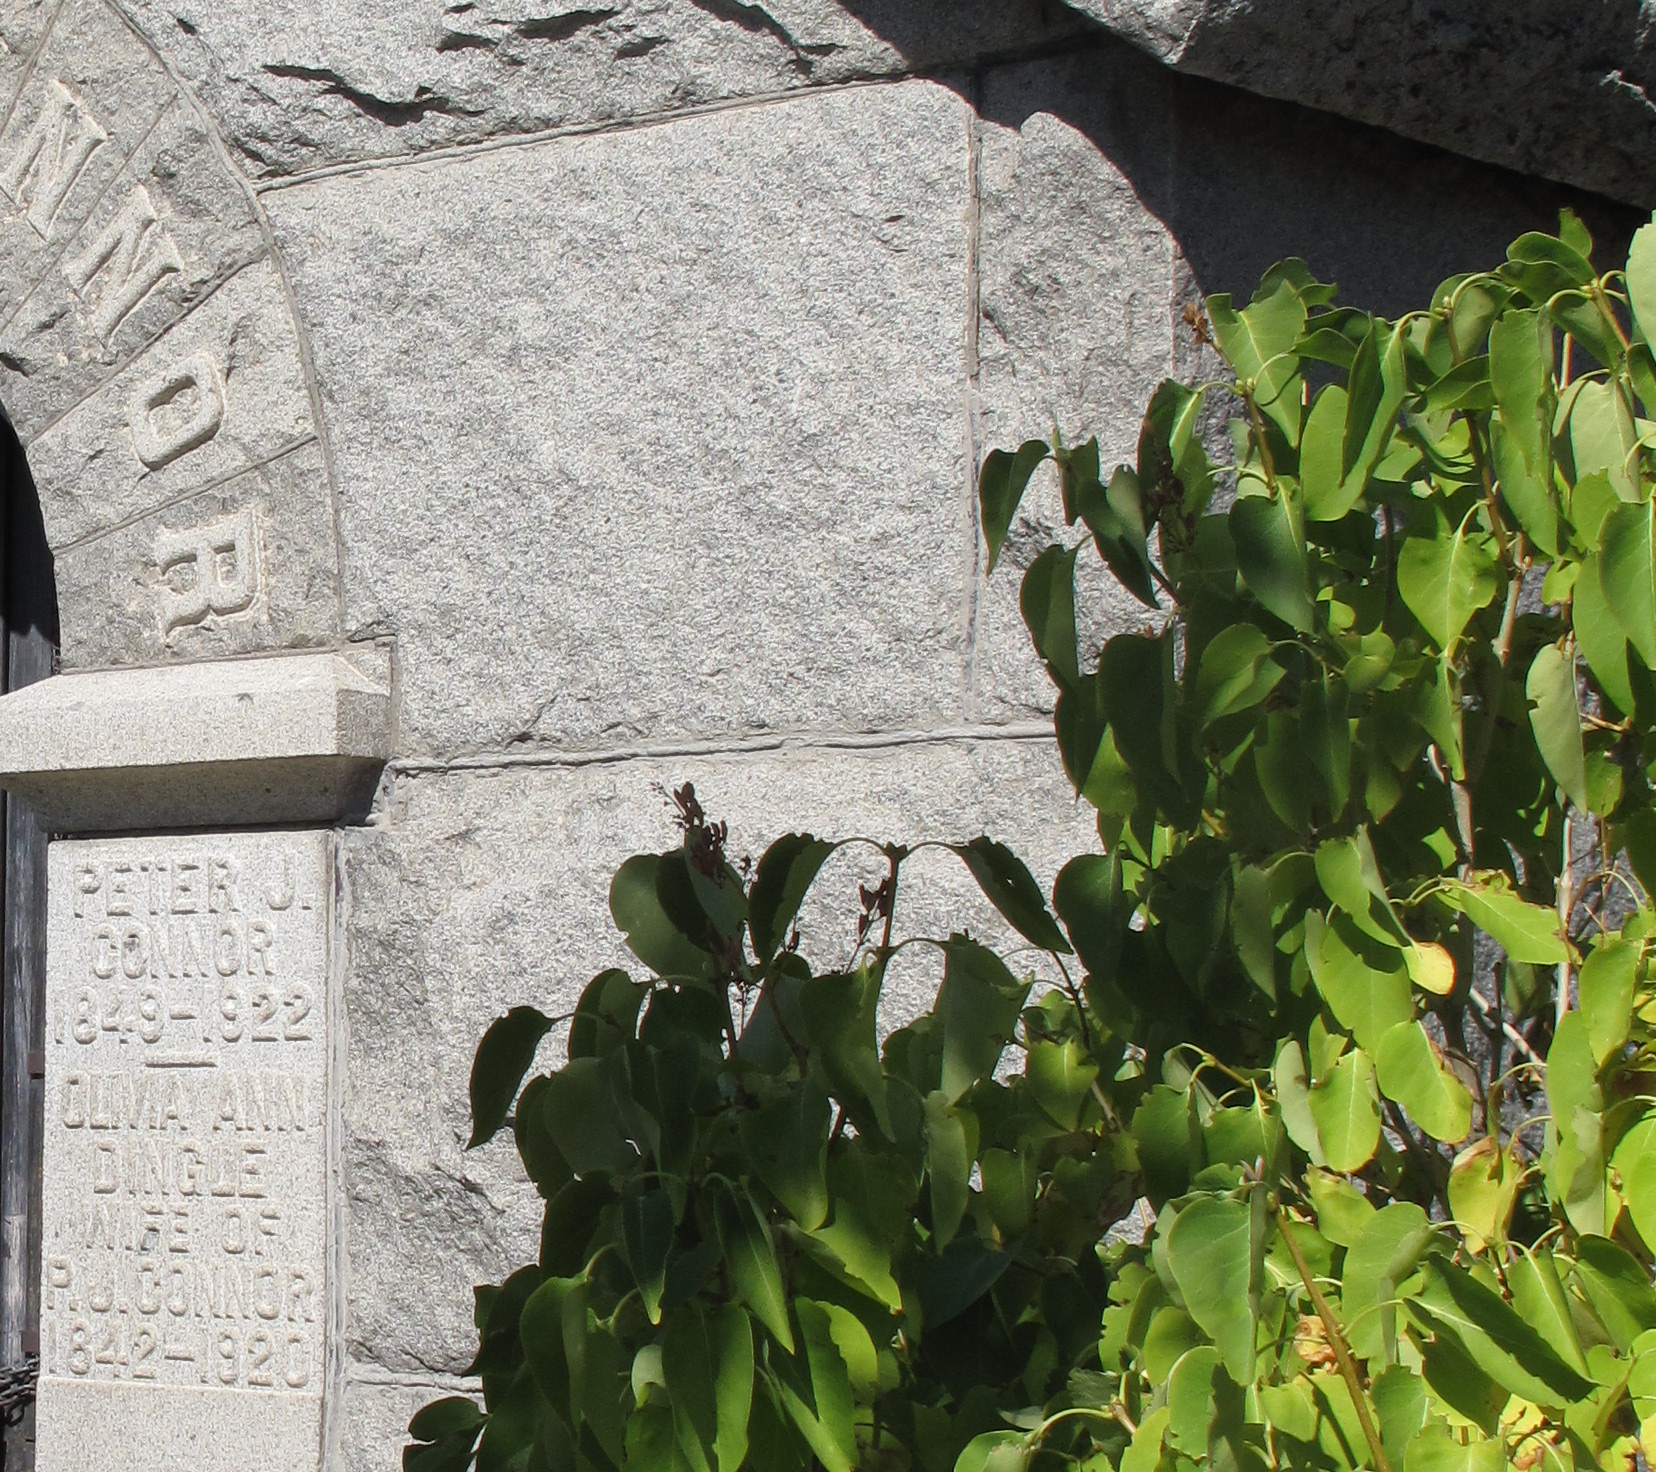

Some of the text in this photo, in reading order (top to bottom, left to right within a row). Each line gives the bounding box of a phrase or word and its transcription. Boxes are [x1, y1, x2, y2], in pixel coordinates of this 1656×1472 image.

[71, 855, 241, 919] PETER
[92, 919, 274, 980] CONNOR
[92, 1137, 268, 1199] DINGLE
[220, 1204, 281, 1256] OF
[46, 1322, 311, 1389] 1842-1920
